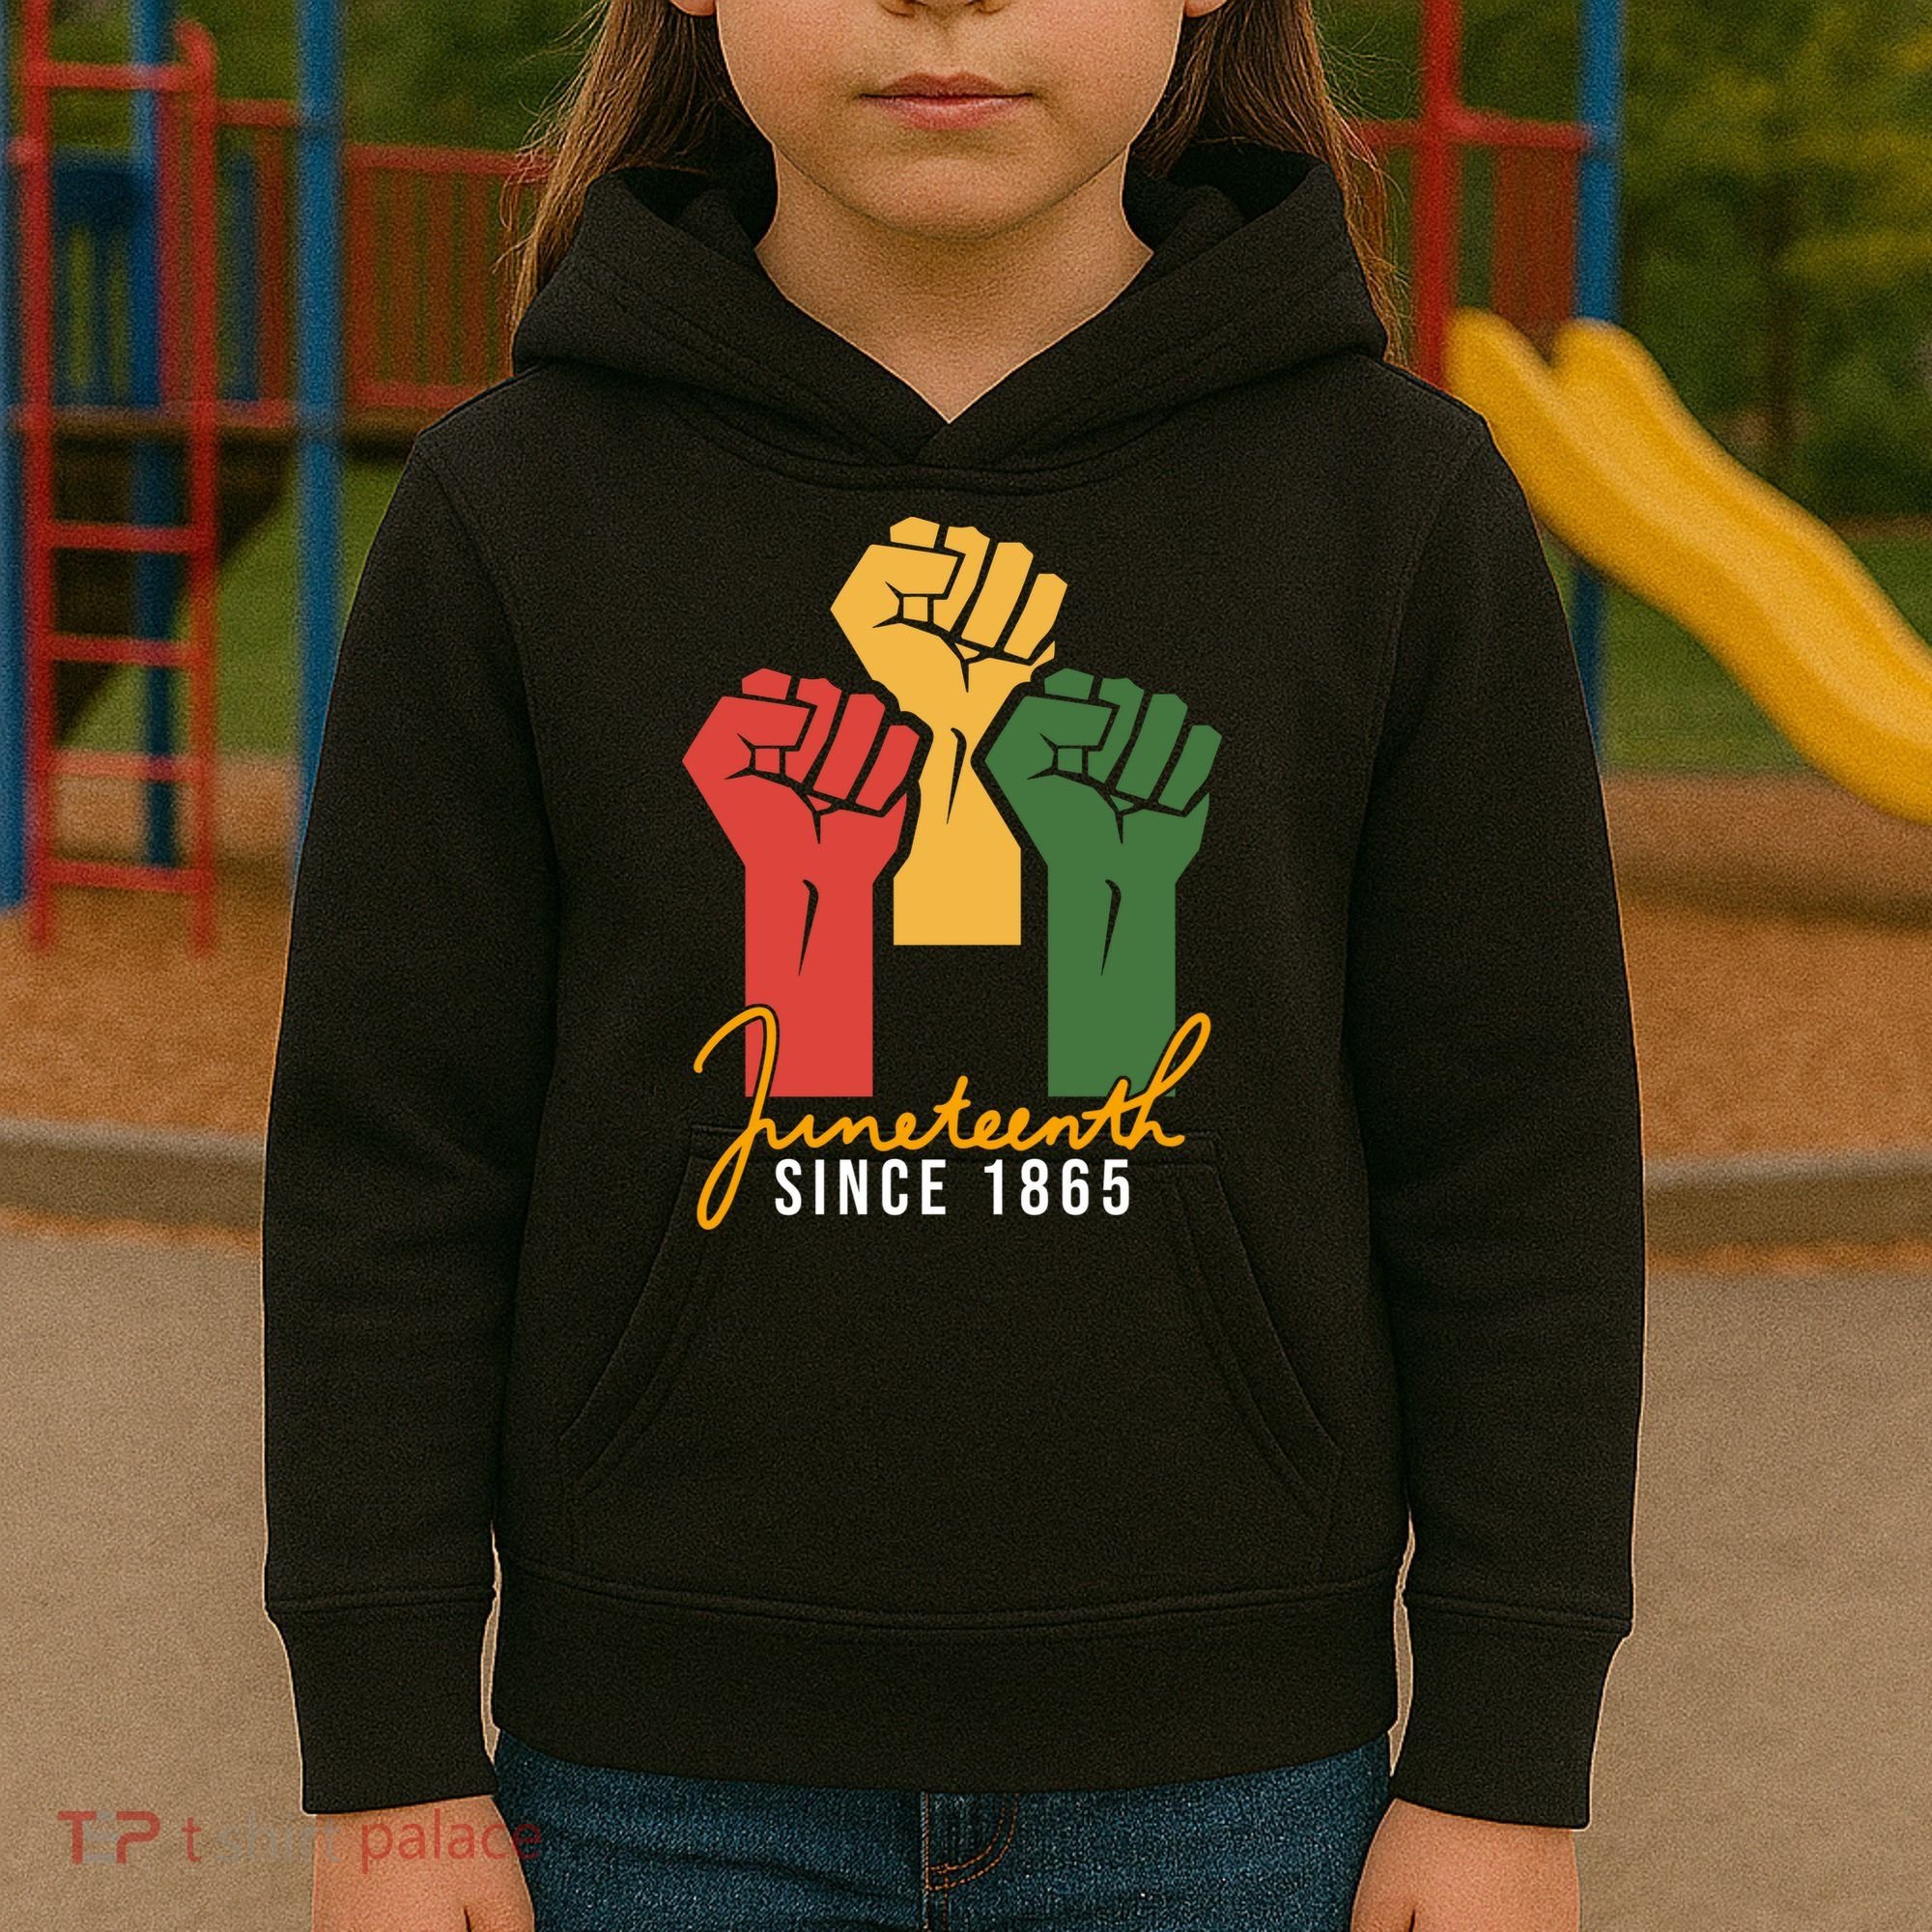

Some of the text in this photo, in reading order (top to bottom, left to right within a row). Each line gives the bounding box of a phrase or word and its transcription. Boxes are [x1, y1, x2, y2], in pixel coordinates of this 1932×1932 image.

[693, 1006, 1212, 1231] Juneteenth
[774, 1158, 1130, 1216] SINCE 1865
